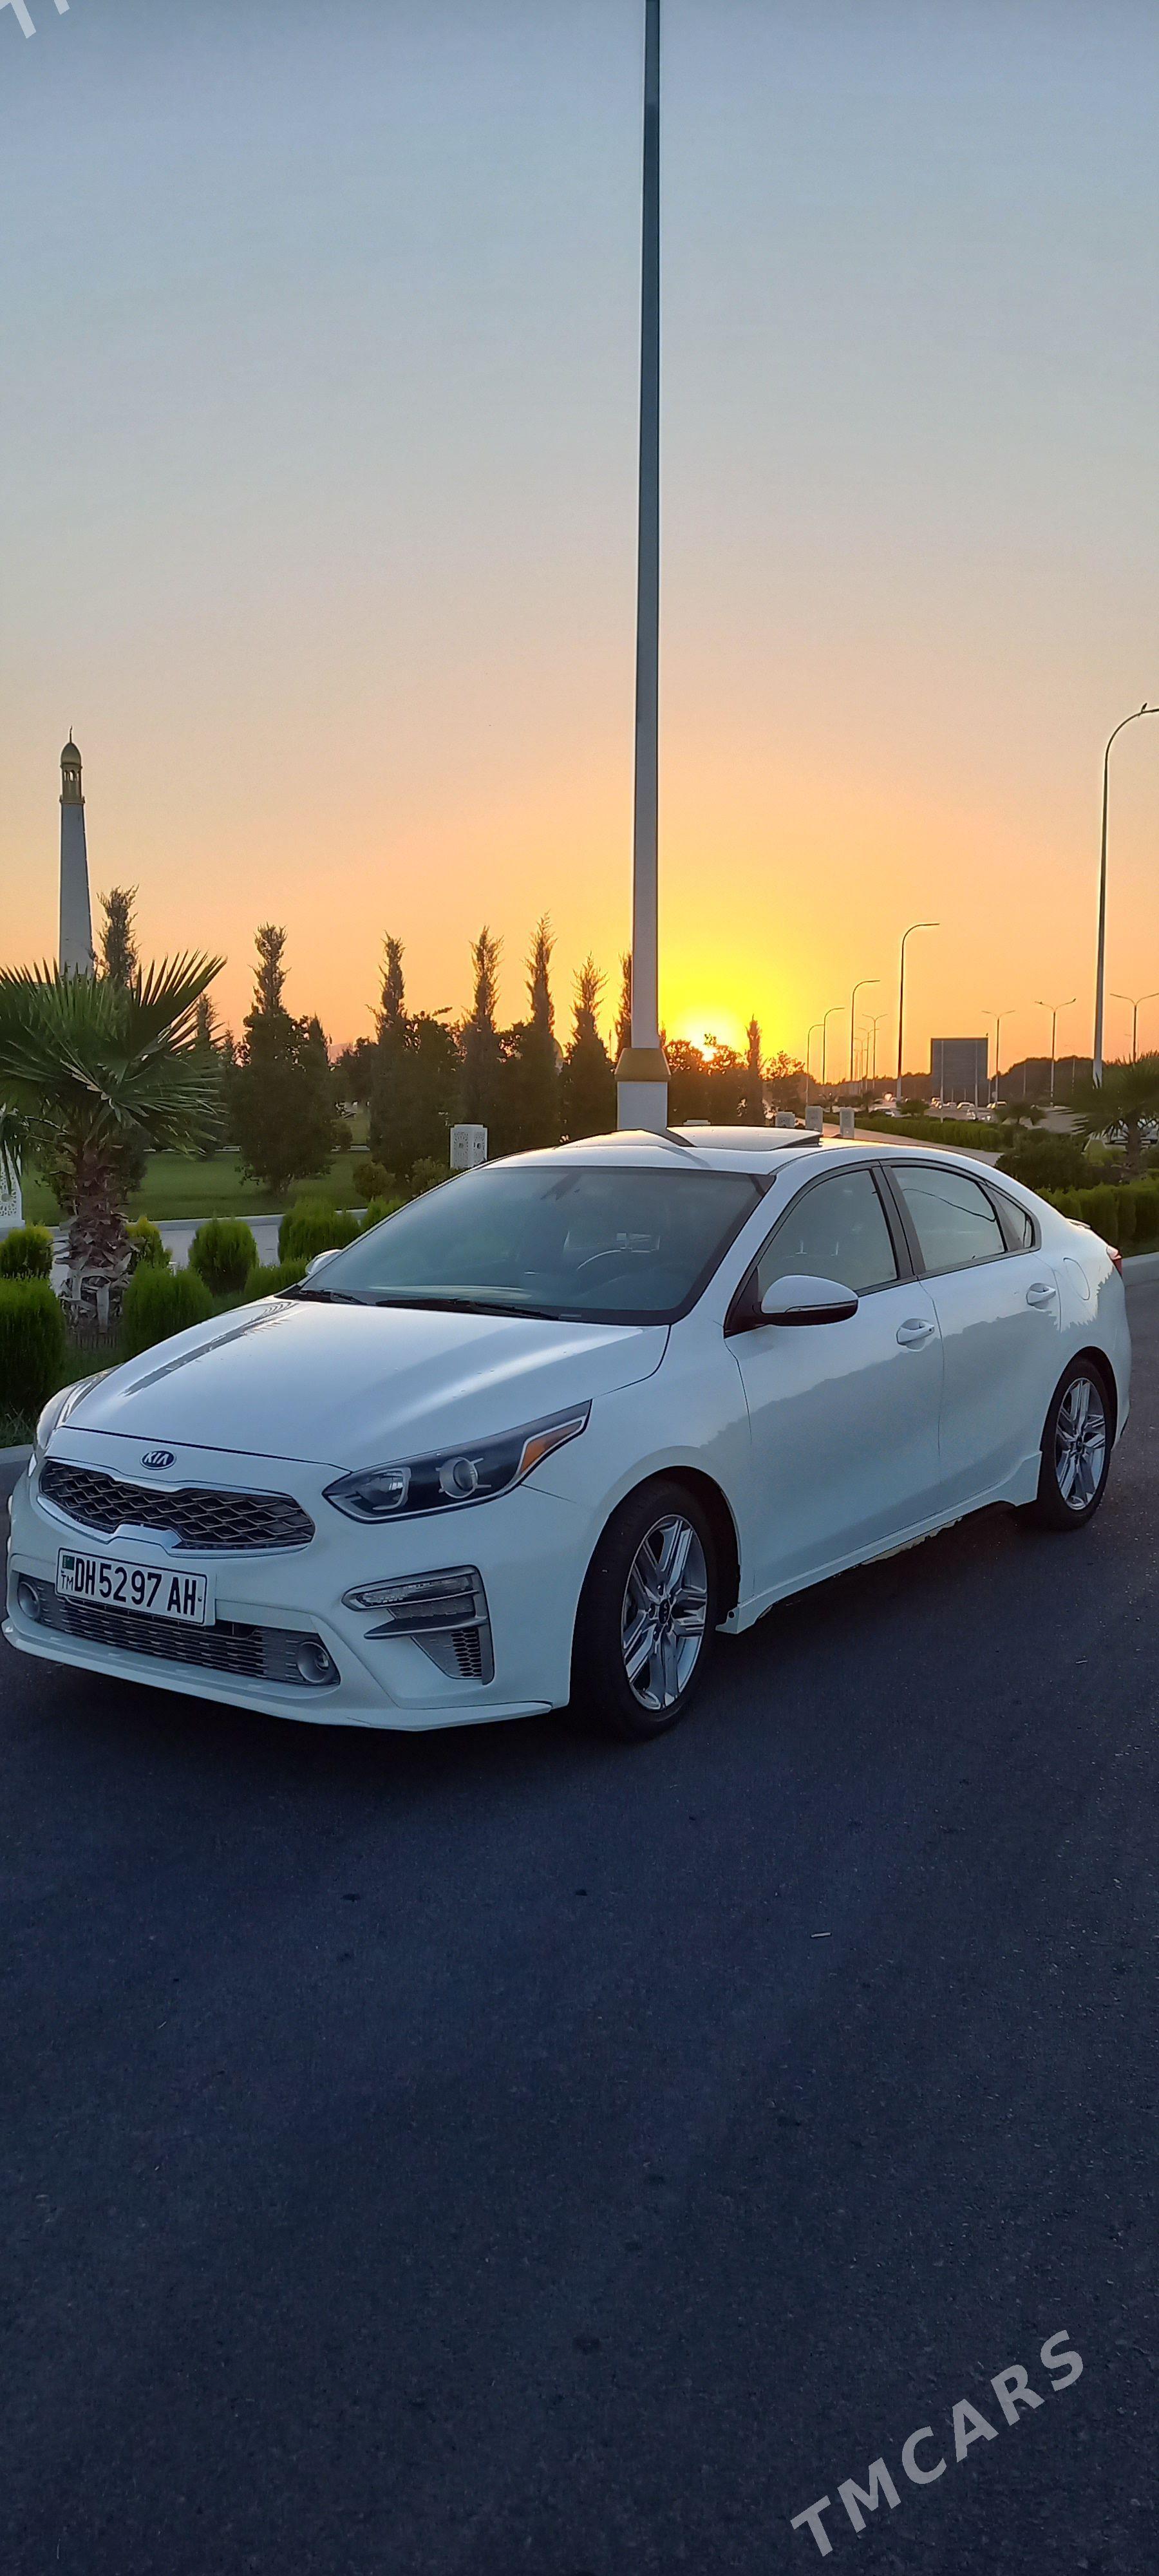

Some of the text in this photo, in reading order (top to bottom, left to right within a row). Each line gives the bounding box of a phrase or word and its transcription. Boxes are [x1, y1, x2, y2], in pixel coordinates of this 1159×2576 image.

[144, 1452, 169, 1465] KIA
[61, 1574, 73, 1591] TM
[167, 1576, 196, 1616] AH
